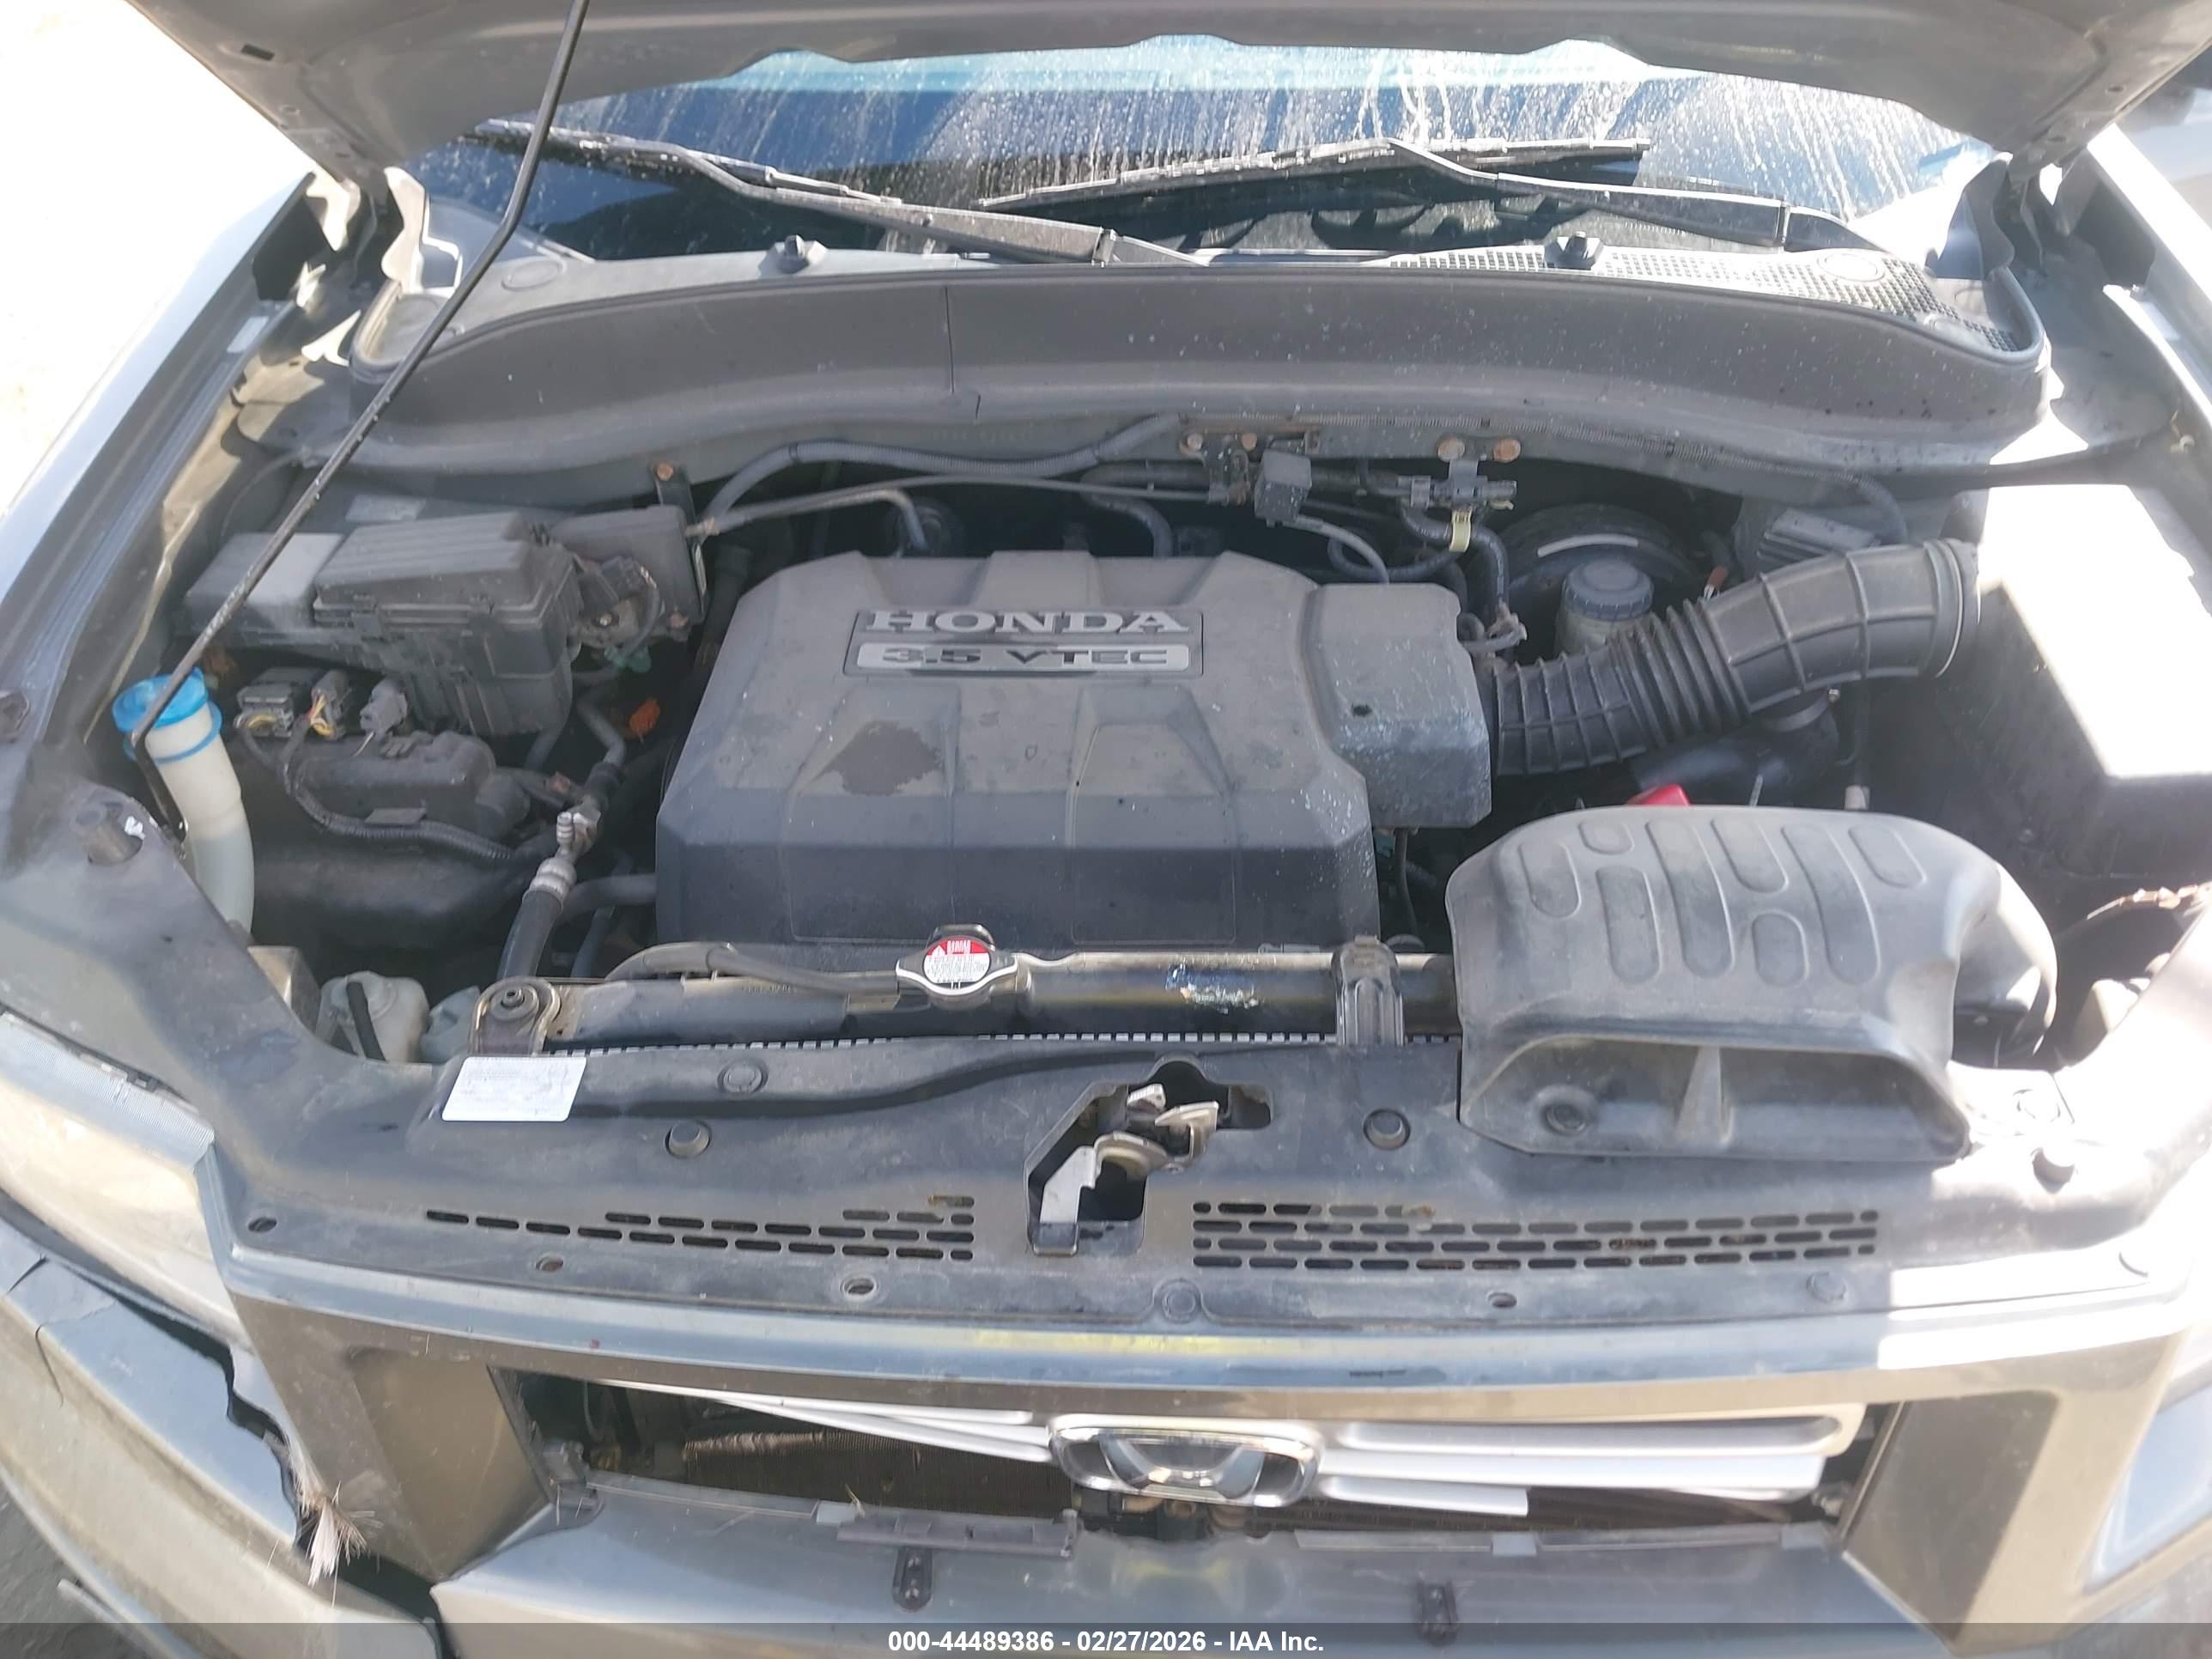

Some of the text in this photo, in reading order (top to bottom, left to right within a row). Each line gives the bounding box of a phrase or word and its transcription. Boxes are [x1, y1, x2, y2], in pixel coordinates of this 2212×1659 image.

[866, 611, 1188, 633] HONDA
[882, 647, 1168, 665] 3.5 VTEC
